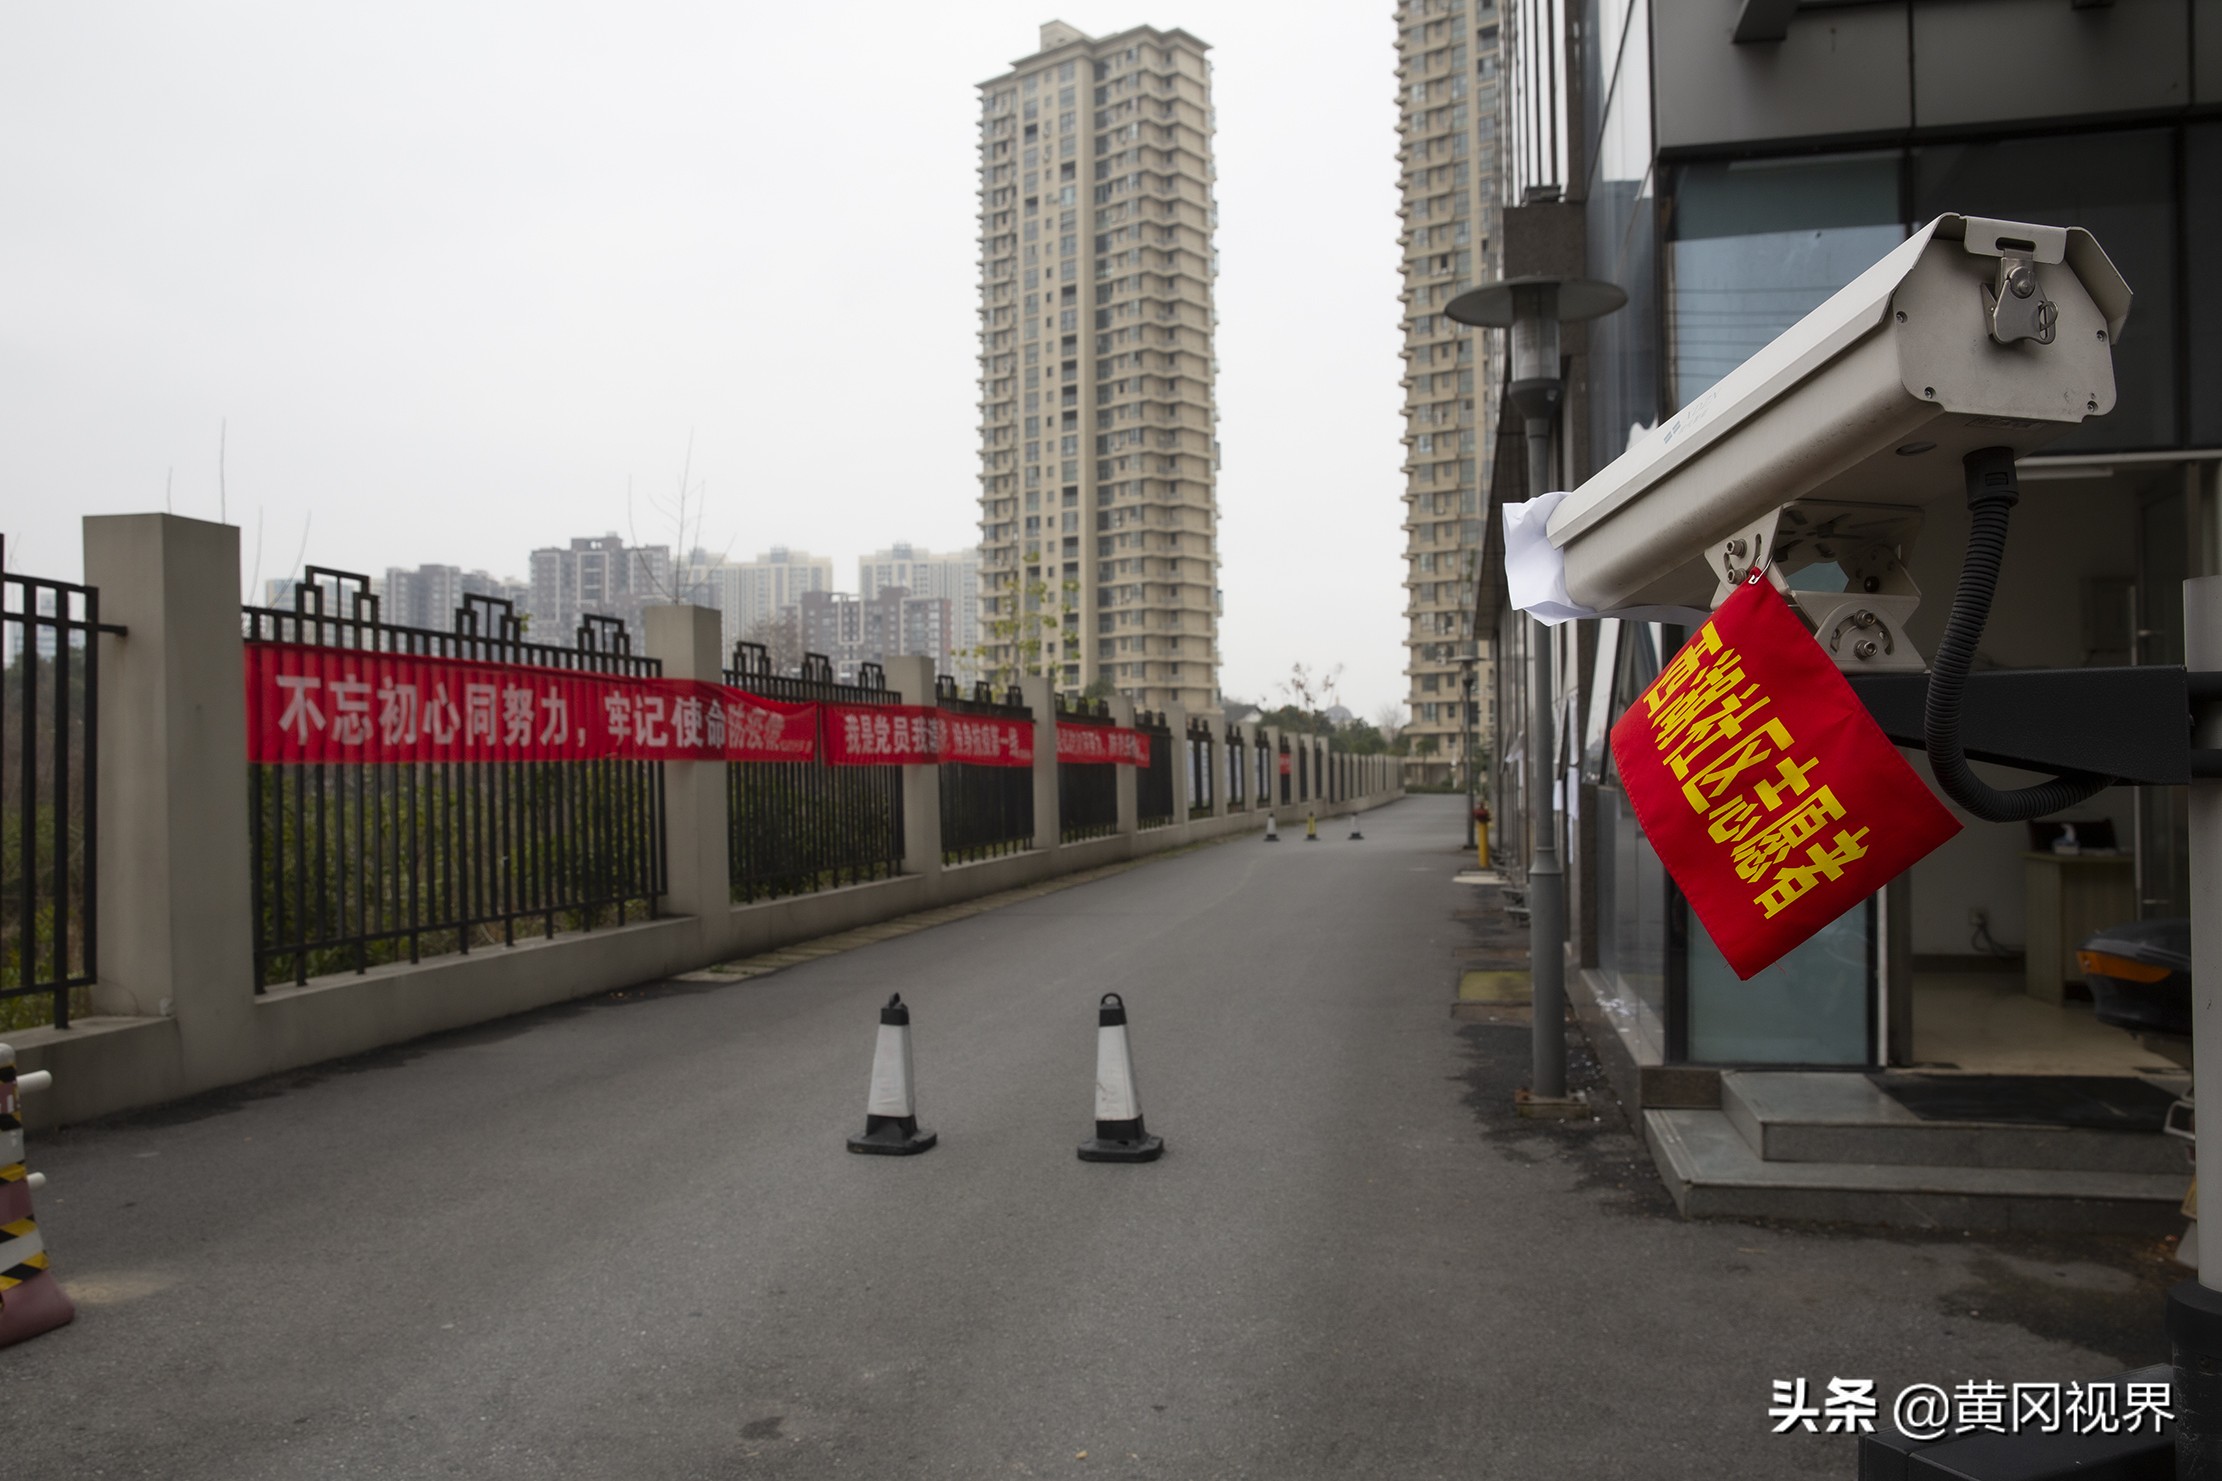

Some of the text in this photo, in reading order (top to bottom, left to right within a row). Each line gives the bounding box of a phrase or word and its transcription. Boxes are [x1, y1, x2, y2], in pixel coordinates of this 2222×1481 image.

[1643, 621, 1871, 919] 西湖社区志愿者
